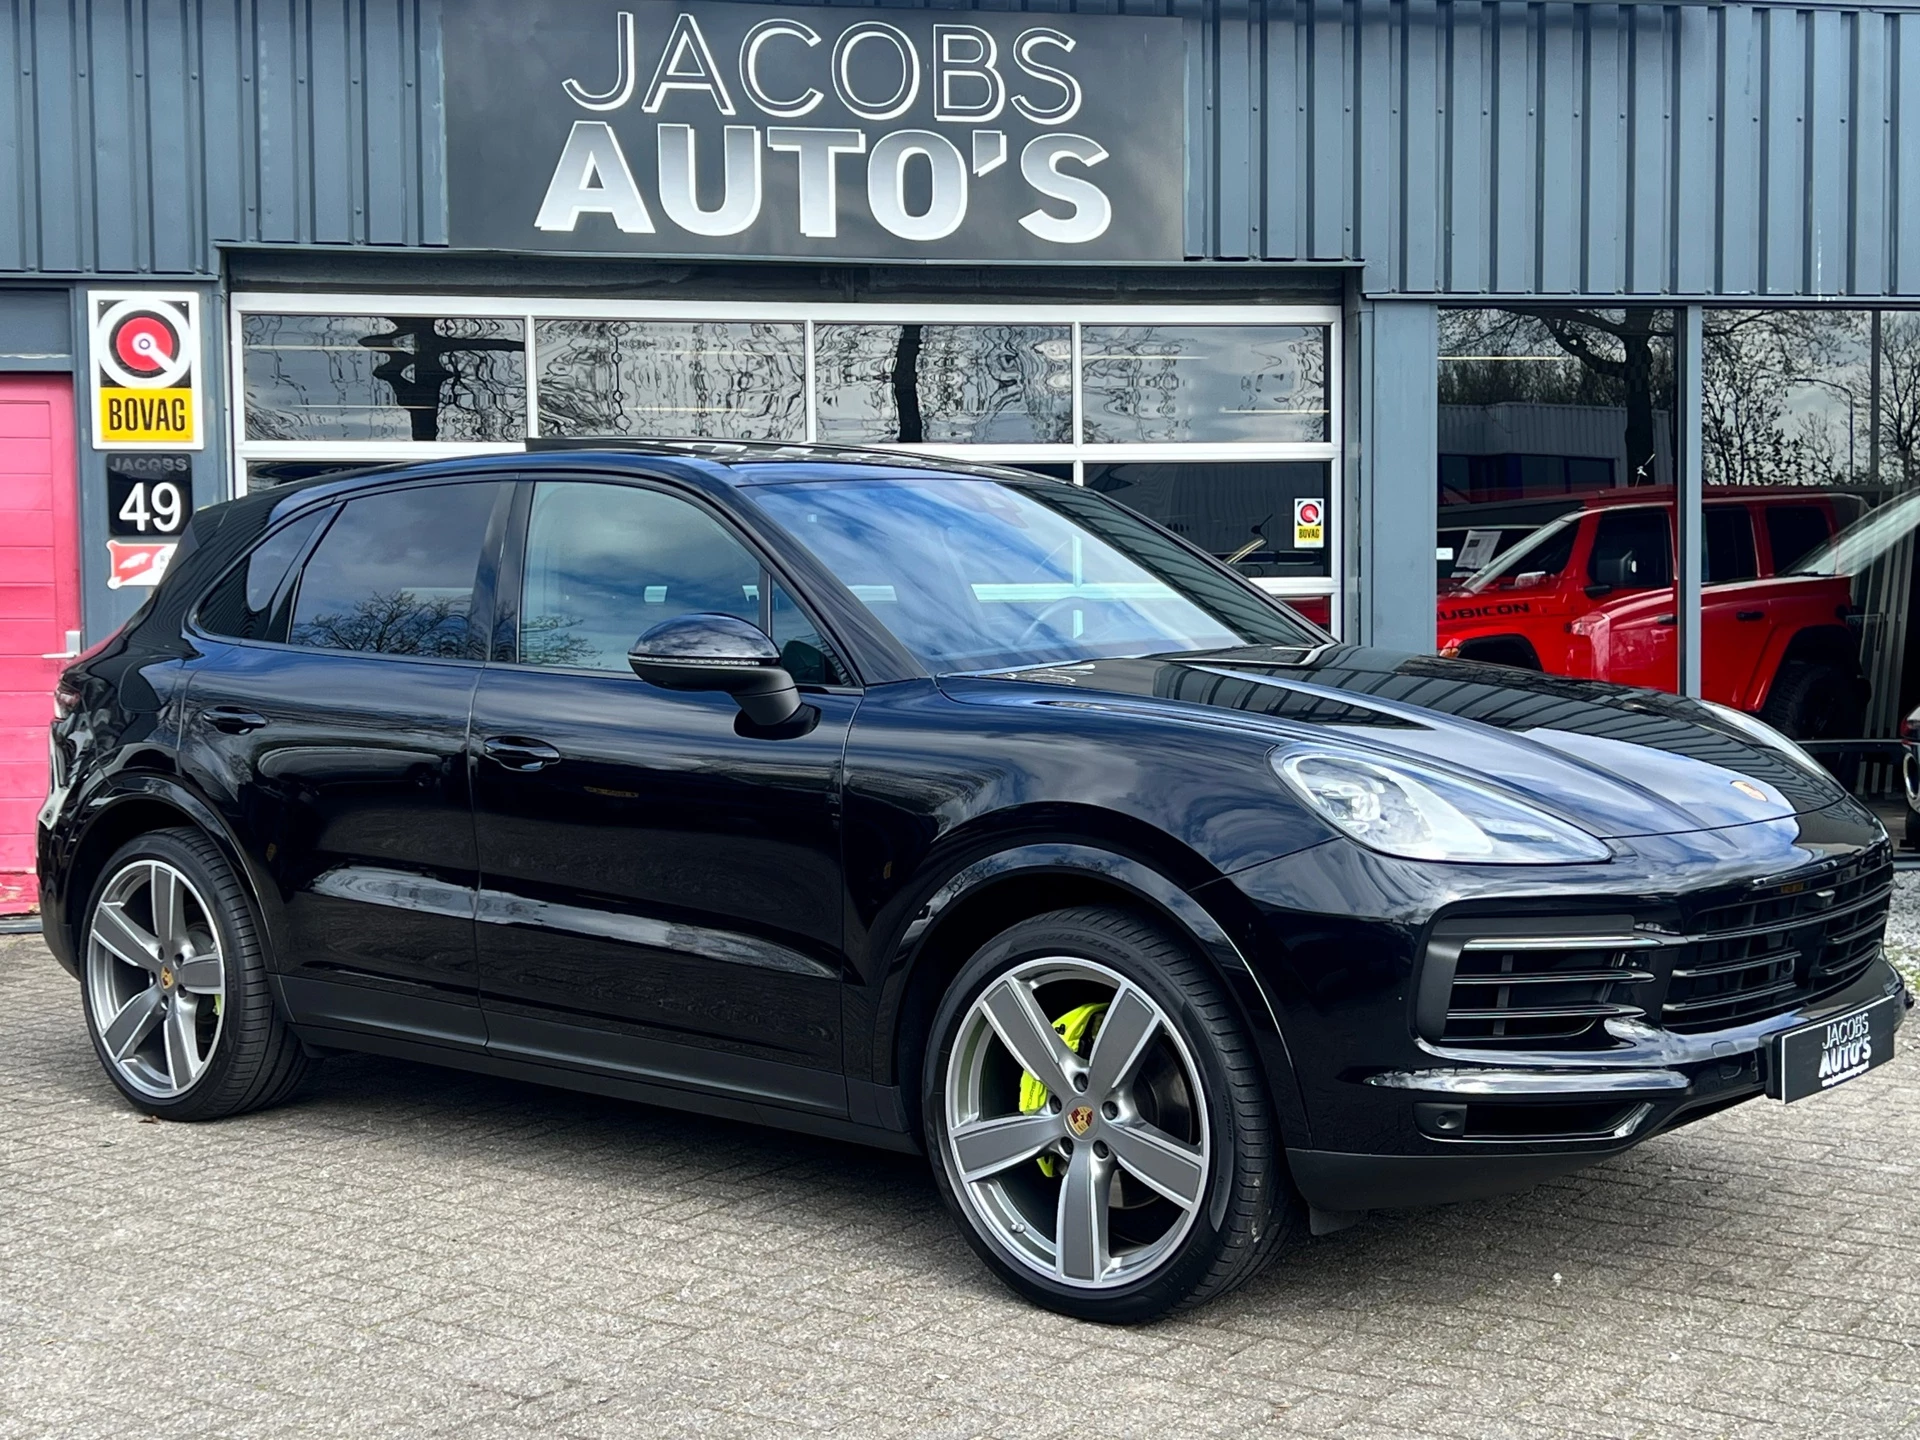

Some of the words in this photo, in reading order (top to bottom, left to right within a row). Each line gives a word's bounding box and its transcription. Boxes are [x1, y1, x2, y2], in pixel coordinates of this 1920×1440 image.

[562, 11, 1082, 125] JACOBS
[534, 120, 1111, 244] AUTO'S
[108, 397, 186, 432] BOVAG
[110, 457, 188, 472] JACOBS
[119, 481, 182, 532] 49
[1298, 528, 1320, 539] BOVAG
[1437, 602, 1530, 620] UBICON
[1821, 1012, 1869, 1050] JACOBS
[1818, 1035, 1872, 1078] AUTO'S
